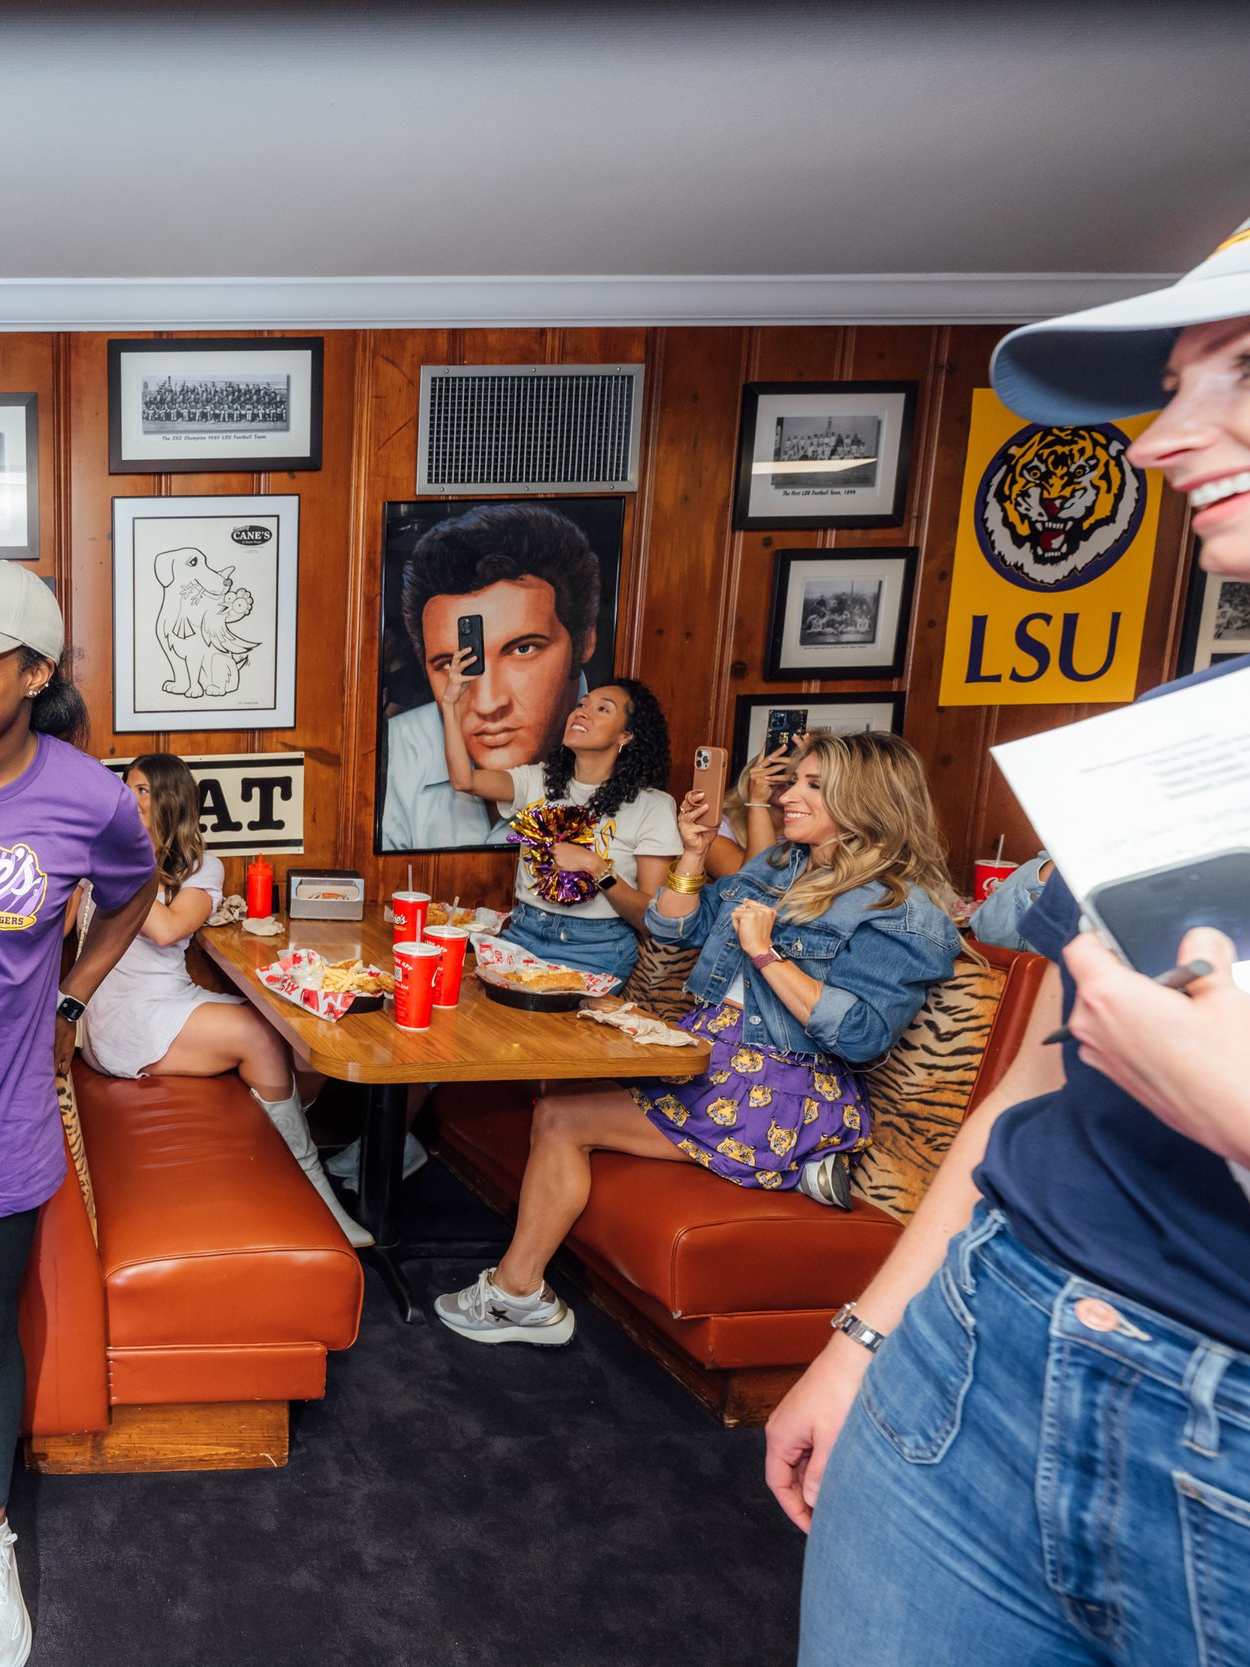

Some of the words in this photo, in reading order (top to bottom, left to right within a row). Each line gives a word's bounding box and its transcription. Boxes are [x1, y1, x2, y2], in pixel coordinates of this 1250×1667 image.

[232, 531, 270, 540] CANE'S
[965, 612, 1122, 684] LSU
[198, 776, 295, 833] AT
